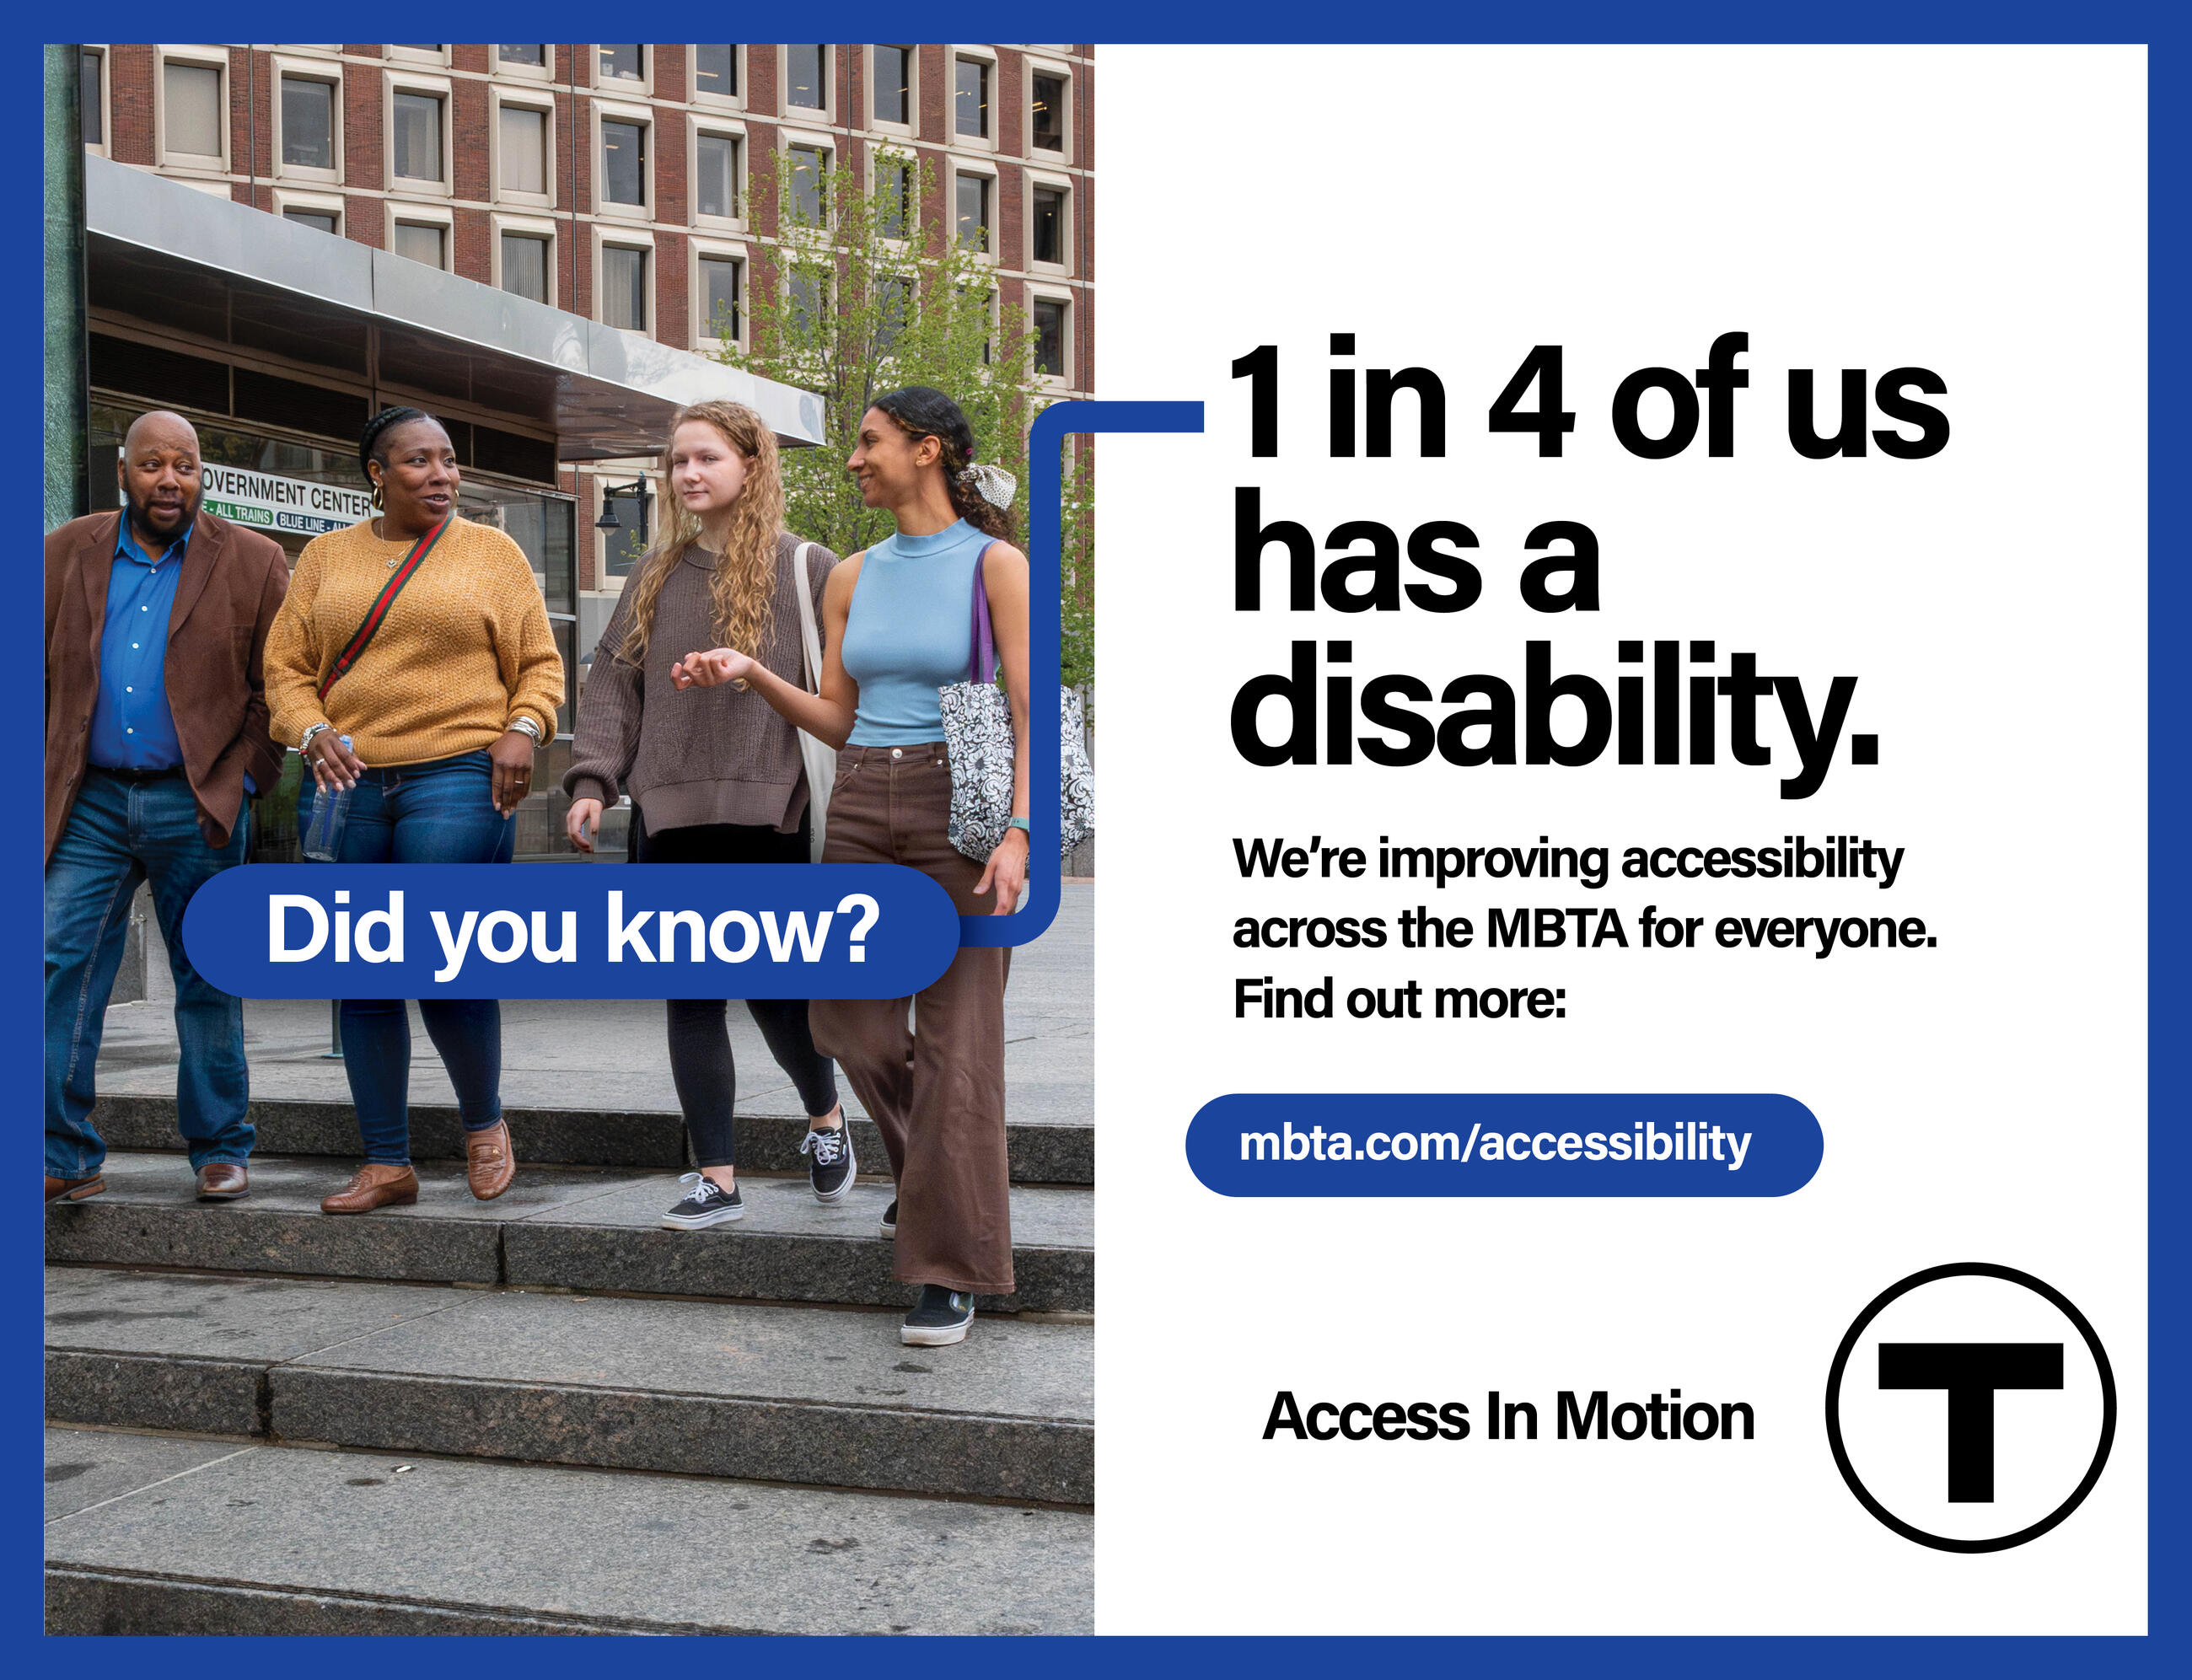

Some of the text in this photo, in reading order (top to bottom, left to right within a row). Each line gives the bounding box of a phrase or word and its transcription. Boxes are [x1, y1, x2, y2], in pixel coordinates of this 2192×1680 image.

[1233, 332, 1949, 459] 1 in 4 of us
[216, 503, 234, 518] ALL
[235, 506, 271, 524] TRAINS
[280, 513, 304, 529] BLUE
[305, 516, 325, 532] LINE
[311, 487, 371, 518] CENTER
[1235, 487, 1599, 613] has a
[1231, 641, 1878, 799] disability.
[1233, 836, 1905, 887] We’re improving accessibility
[1233, 905, 1937, 958] across the MBTA for everyone.
[1236, 976, 1565, 1018] Find out more:
[1241, 1122, 1752, 1170] mbta.com/accessibility
[1262, 1389, 1754, 1440] Access In Motion
[1878, 1343, 2064, 1503] T
